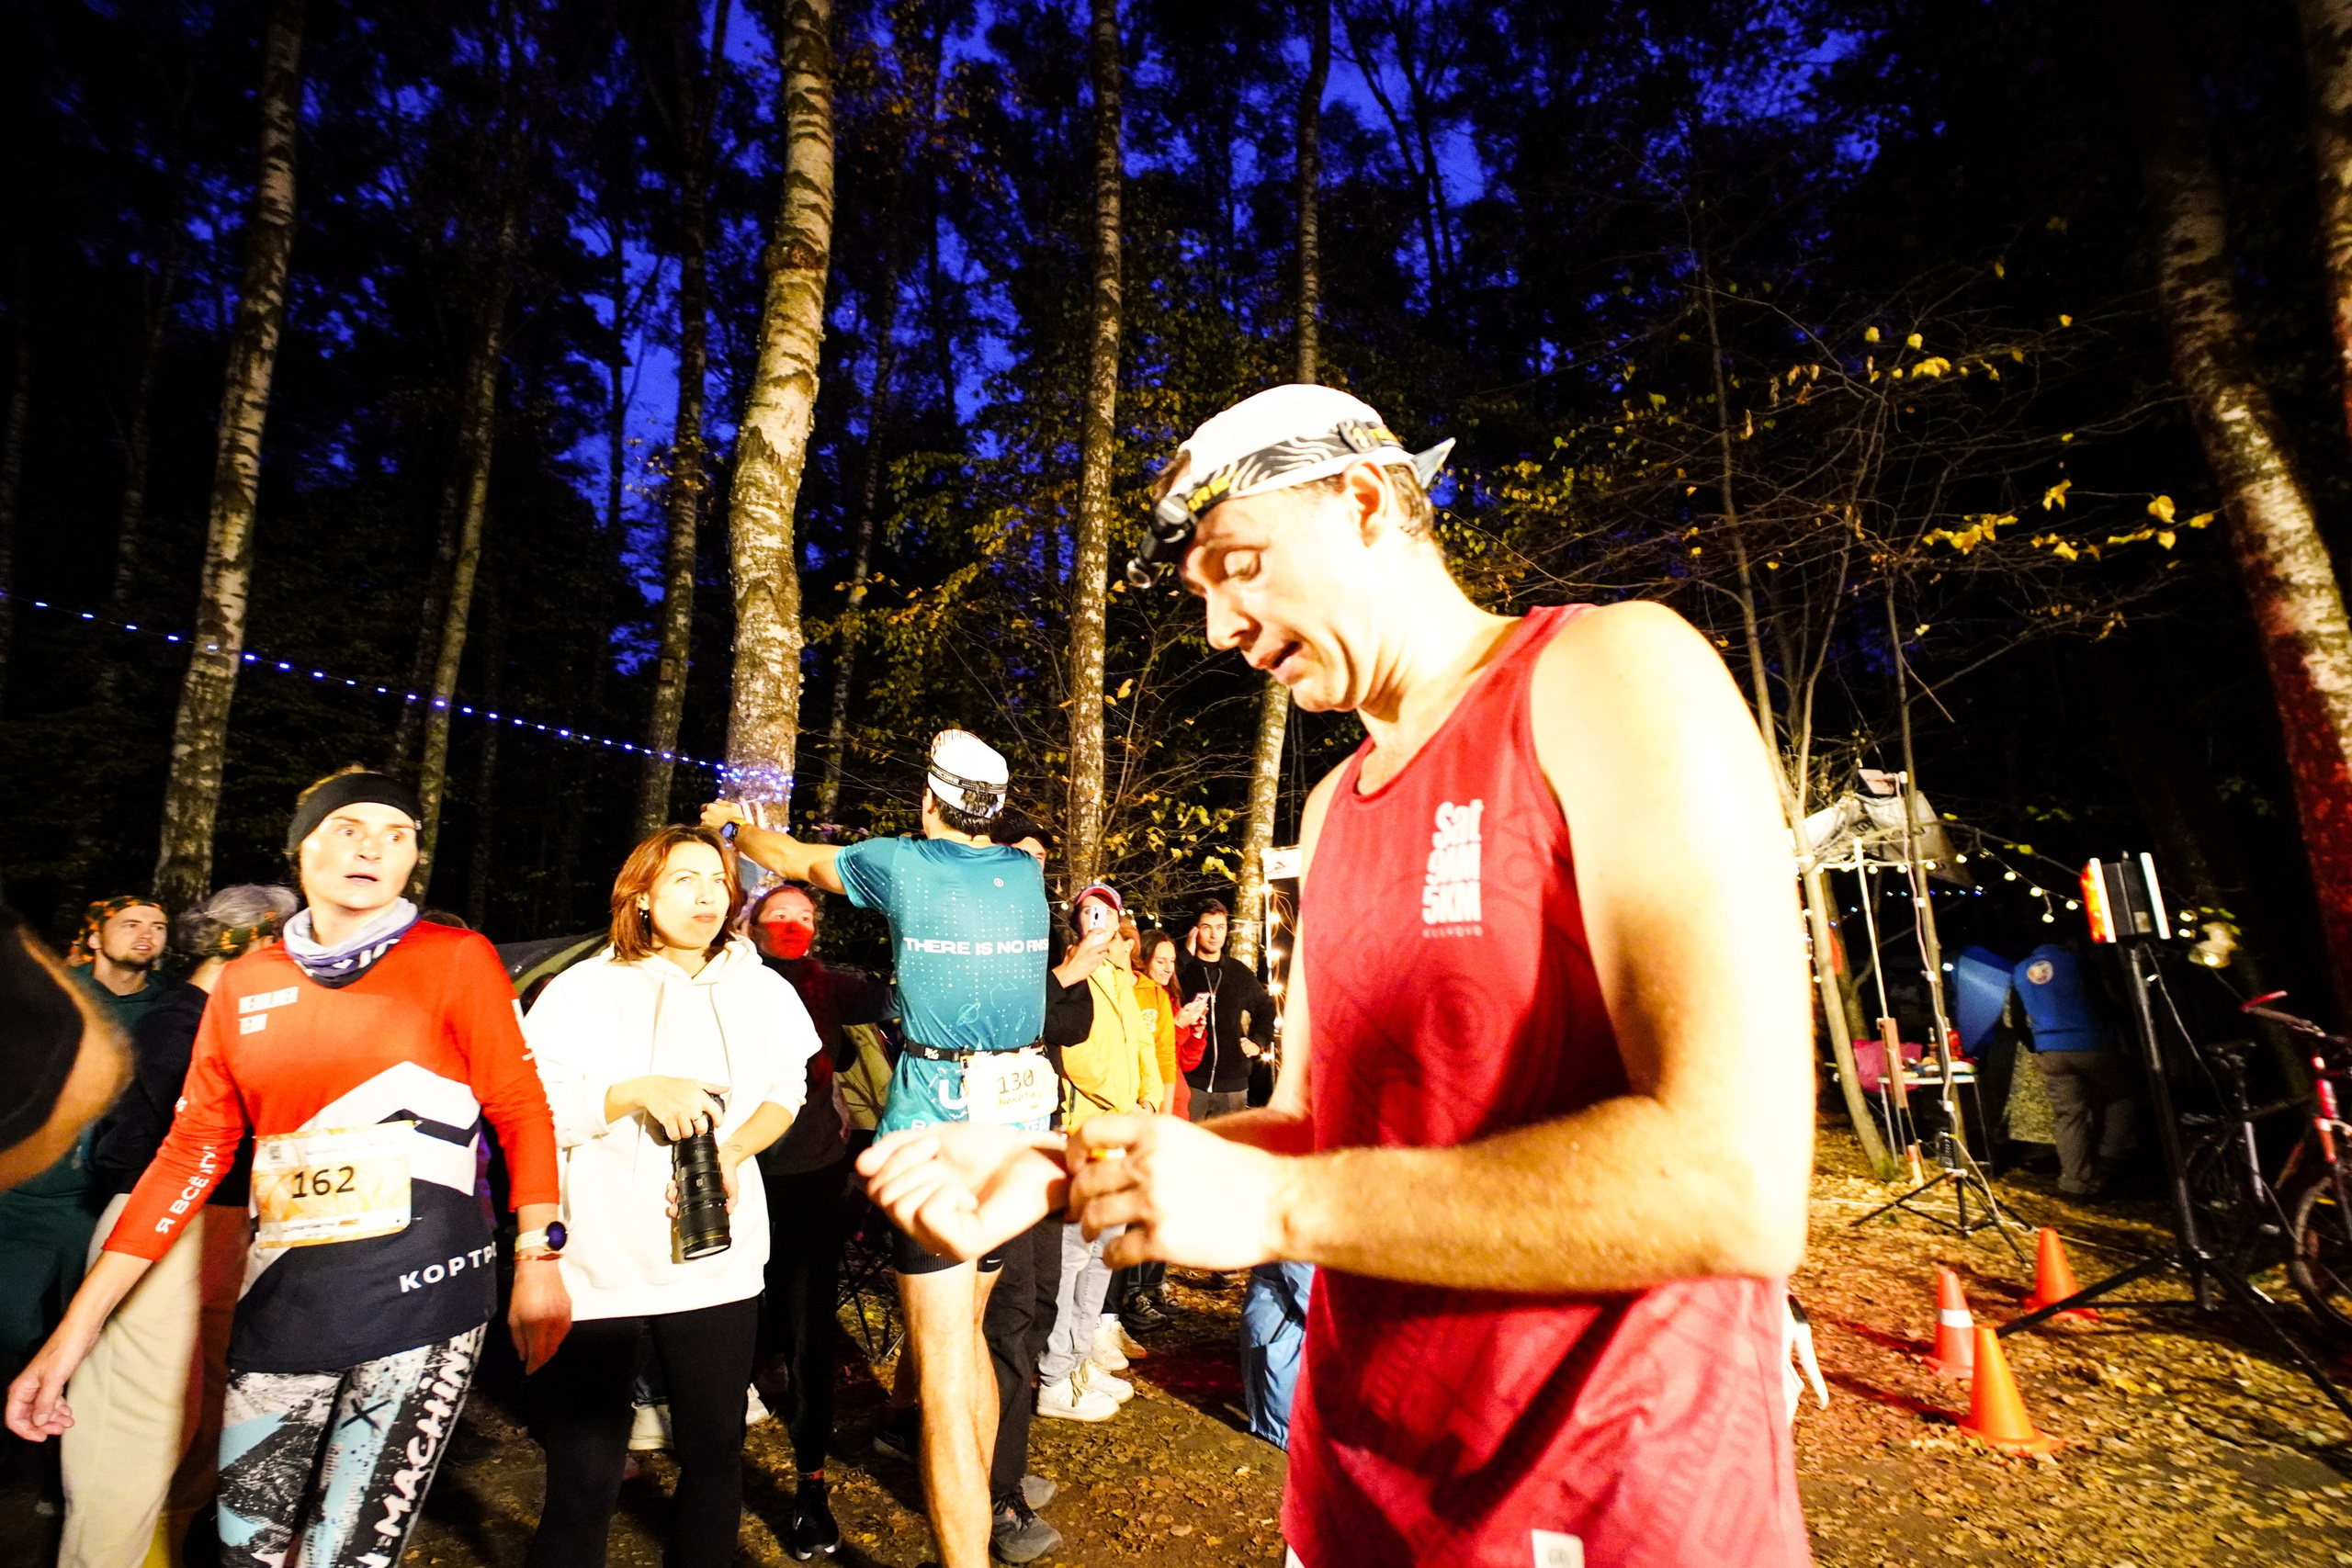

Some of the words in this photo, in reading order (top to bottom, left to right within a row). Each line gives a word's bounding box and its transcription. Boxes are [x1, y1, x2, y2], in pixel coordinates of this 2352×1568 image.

[1422, 880, 1482, 925] 5KM
[903, 937, 971, 955] THERE
[975, 942, 993, 955] IS
[997, 940, 1024, 954] NO
[997, 1068, 1035, 1094] 130
[291, 1166, 355, 1199] 162
[155, 1217, 176, 1235] Я
[169, 1176, 209, 1214] ВСЁ
[399, 1240, 497, 1293] КОРТР
